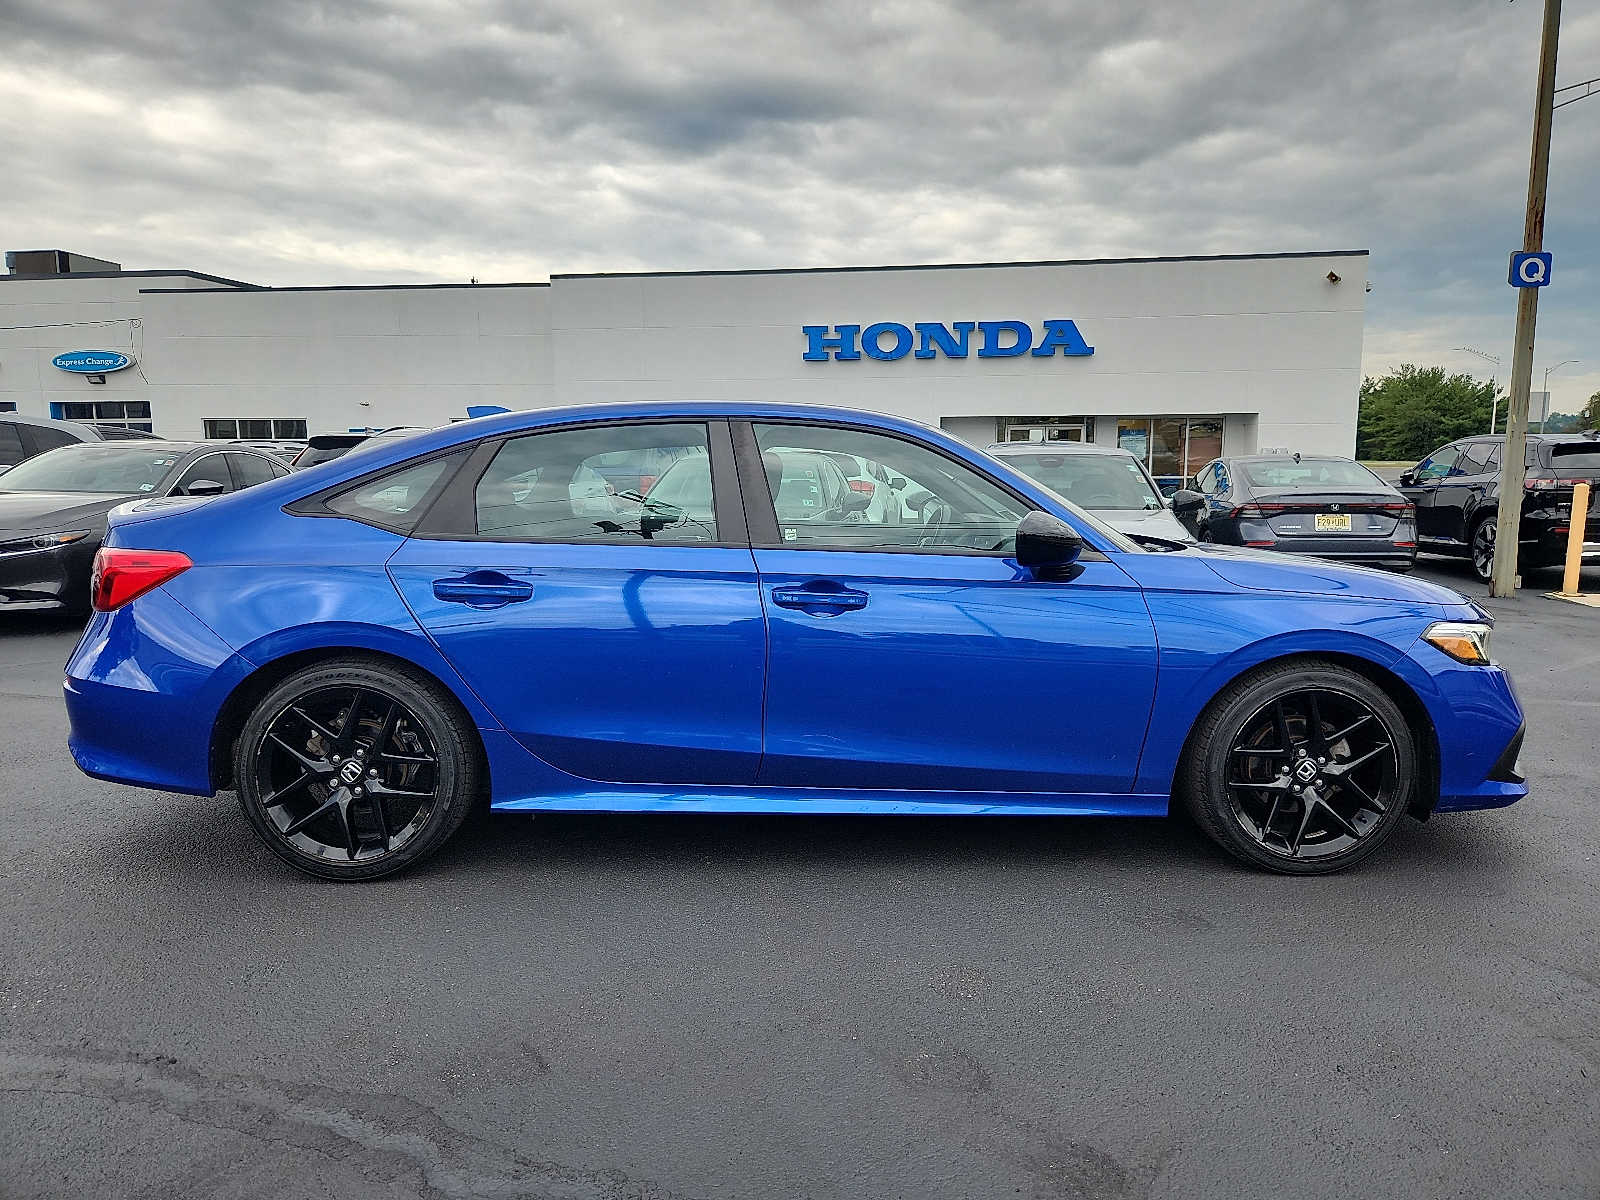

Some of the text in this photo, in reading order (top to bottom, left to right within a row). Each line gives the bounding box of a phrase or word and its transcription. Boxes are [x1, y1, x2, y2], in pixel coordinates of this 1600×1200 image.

[1520, 257, 1545, 283] Q
[802, 319, 1095, 361] HONDA
[56, 357, 113, 367] Express Change
